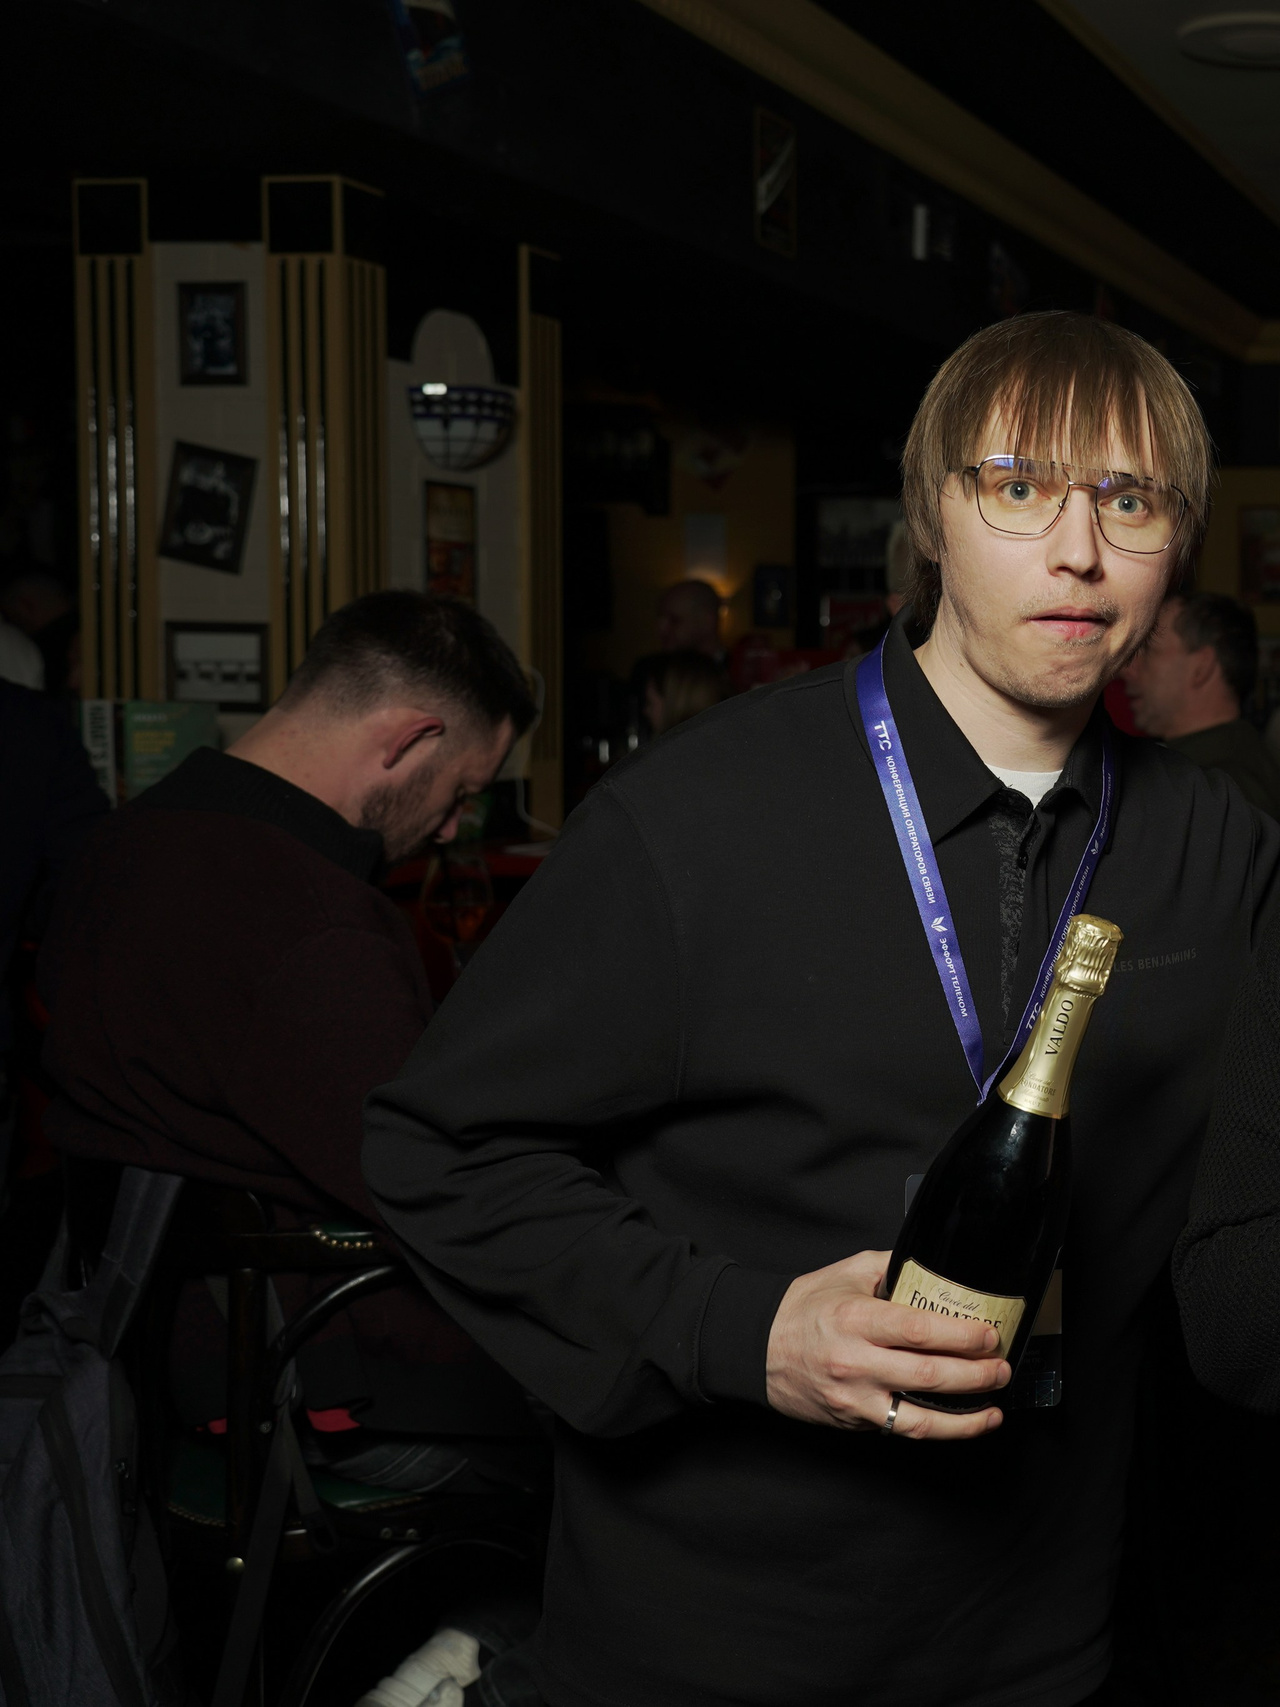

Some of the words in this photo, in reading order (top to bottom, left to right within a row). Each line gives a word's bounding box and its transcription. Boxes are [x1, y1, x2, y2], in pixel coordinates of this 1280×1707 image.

[885, 755, 911, 818] КОНФЕРЕНЦИЯ
[905, 819, 927, 875] ОПЕРАТОРОВ
[922, 876, 936, 904] СВЯЗИ
[1078, 866, 1090, 890] СВЯЗИ
[940, 938, 957, 974] ЭФФОРТ
[951, 975, 968, 1017] ТЕЛЕКОМ
[1114, 960, 1134, 973] LES
[1137, 947, 1197, 970] BENJAMINS
[1045, 1000, 1074, 1055] VALDO
[937, 1288, 962, 1307] Cuvée
[962, 1302, 980, 1312] del
